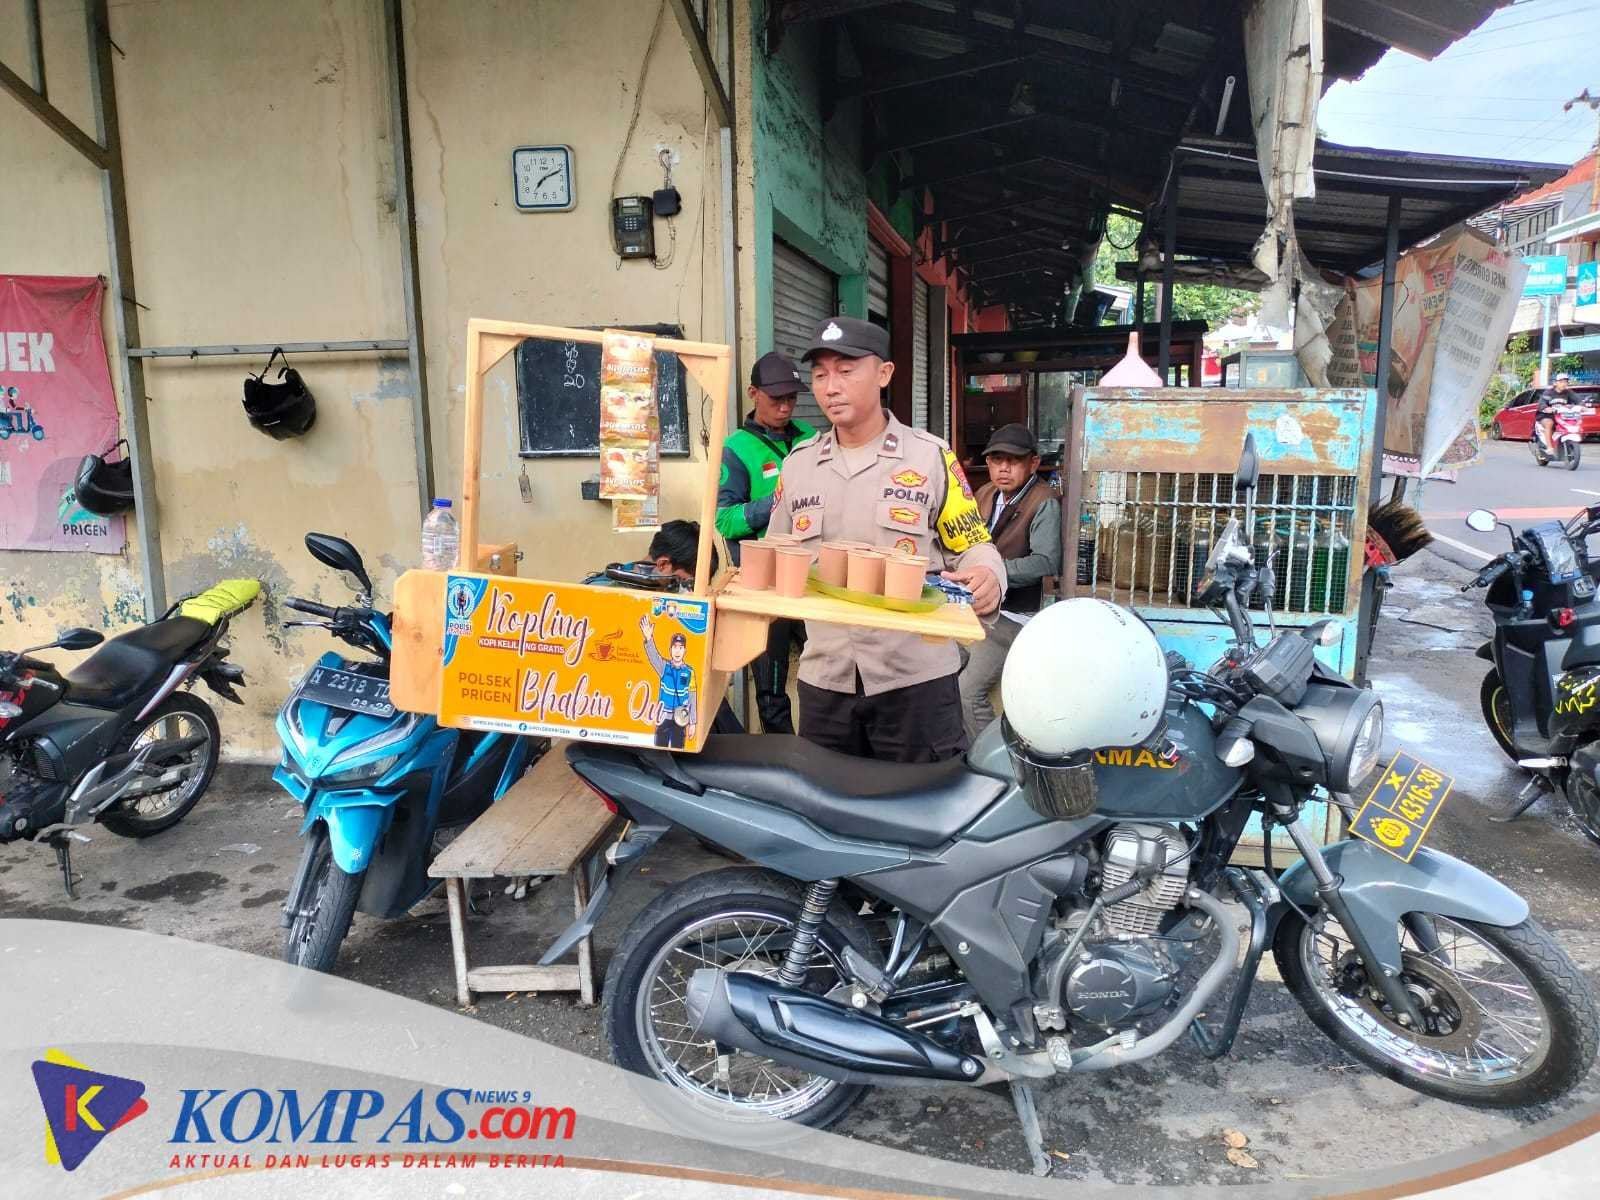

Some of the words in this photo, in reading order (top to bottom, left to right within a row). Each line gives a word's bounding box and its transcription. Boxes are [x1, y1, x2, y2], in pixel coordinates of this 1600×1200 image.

[791, 495, 821, 512] JAMAL
[883, 487, 930, 505] POLRI
[63, 523, 107, 537] PRIGEN
[487, 586, 593, 666] Kopling
[479, 638, 498, 648] KOPI
[497, 640, 537, 652] KELILNG
[538, 643, 565, 654] GRATIS
[310, 669, 325, 686] N
[328, 674, 368, 693] 2318
[458, 671, 512, 689] POLSEK
[461, 688, 511, 704] PRIGEN
[520, 668, 613, 722] Bhabin
[1385, 770, 1407, 792] X
[1398, 768, 1444, 822] 4316-39
[1077, 989, 1130, 1000] HONDA
